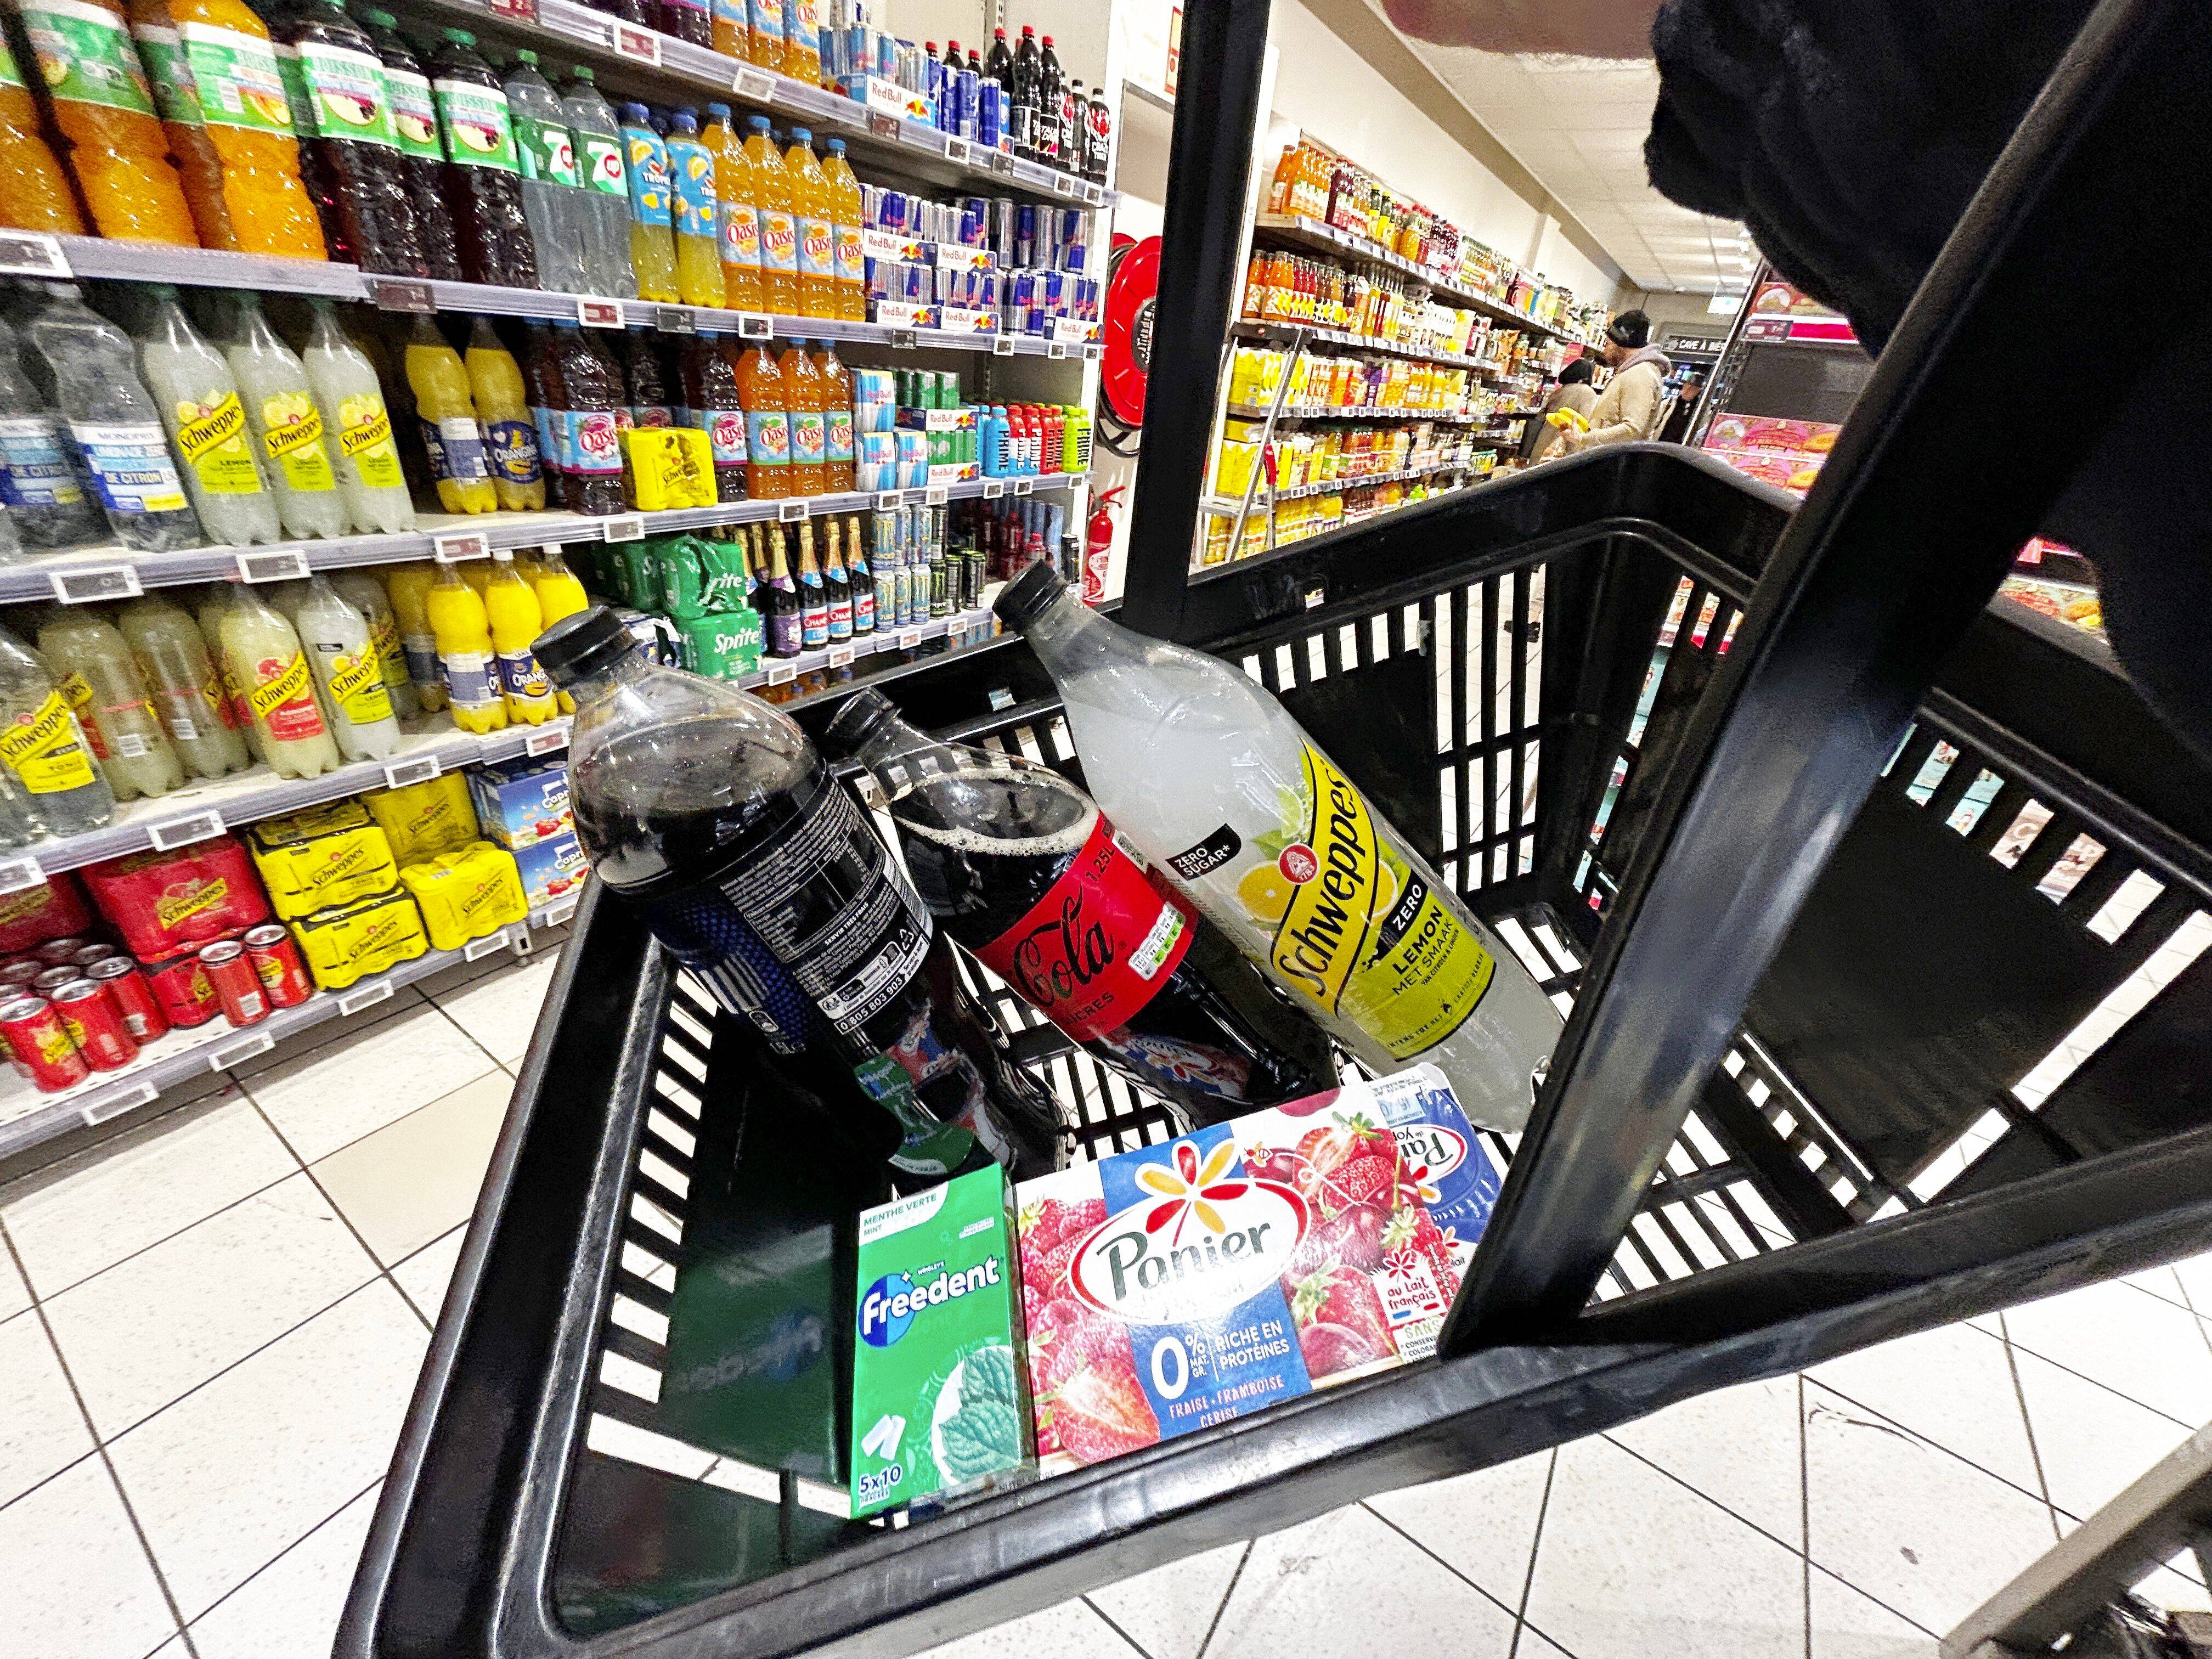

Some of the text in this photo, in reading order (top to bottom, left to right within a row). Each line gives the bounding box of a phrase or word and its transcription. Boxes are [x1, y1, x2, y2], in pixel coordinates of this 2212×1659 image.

[873, 84, 901, 104] Red Bull
[727, 219, 759, 244] Oasis
[764, 226, 795, 250] Oasis
[868, 235, 896, 250] Red Bull
[942, 249, 967, 261] Red Bull
[882, 305, 907, 317] Red Bull
[946, 312, 970, 323] Red Bull
[1679, 340, 1699, 350] CAVE
[930, 414, 941, 422] Red
[998, 430, 1010, 471] PRIME
[1030, 428, 1042, 469] PRIME
[1077, 428, 1091, 466] PRIME
[943, 467, 953, 476] Bull
[714, 627, 759, 655] Sprite
[313, 847, 364, 886] Schweppes
[1174, 848, 1207, 868] ZERO
[1279, 768, 1366, 997] Schweppes
[1298, 865, 1316, 882] 1783
[1392, 884, 1422, 931] ZERO
[349, 921, 398, 959] Schweppes
[1014, 884, 1115, 1010] Cola
[1392, 905, 1444, 975] LEMON
[1392, 918, 1453, 996] MET SMAAK
[1420, 973, 1432, 986] VAN
[840, 977, 903, 1030] 0 805 803 903
[1414, 1024, 1430, 1036] TOT
[1430, 1013, 1443, 1026] HET
[864, 1193, 937, 1227] MENTHE VERTE
[864, 1224, 882, 1236] MINT
[1096, 1222, 1271, 1302] Panier
[1387, 1286, 1402, 1297] au
[1388, 1289, 1437, 1310] français
[1215, 1319, 1283, 1352] RICHE EN
[1404, 1314, 1443, 1339] SANS
[1189, 1355, 1209, 1368] MAT.
[1219, 1338, 1290, 1370] PROTÉINES
[1192, 1367, 1207, 1378] GR.
[1169, 1374, 1285, 1419] FRAISE FRAMBOISE
[1200, 1406, 1238, 1428] CERISE
[860, 1465, 901, 1494] 5x10
